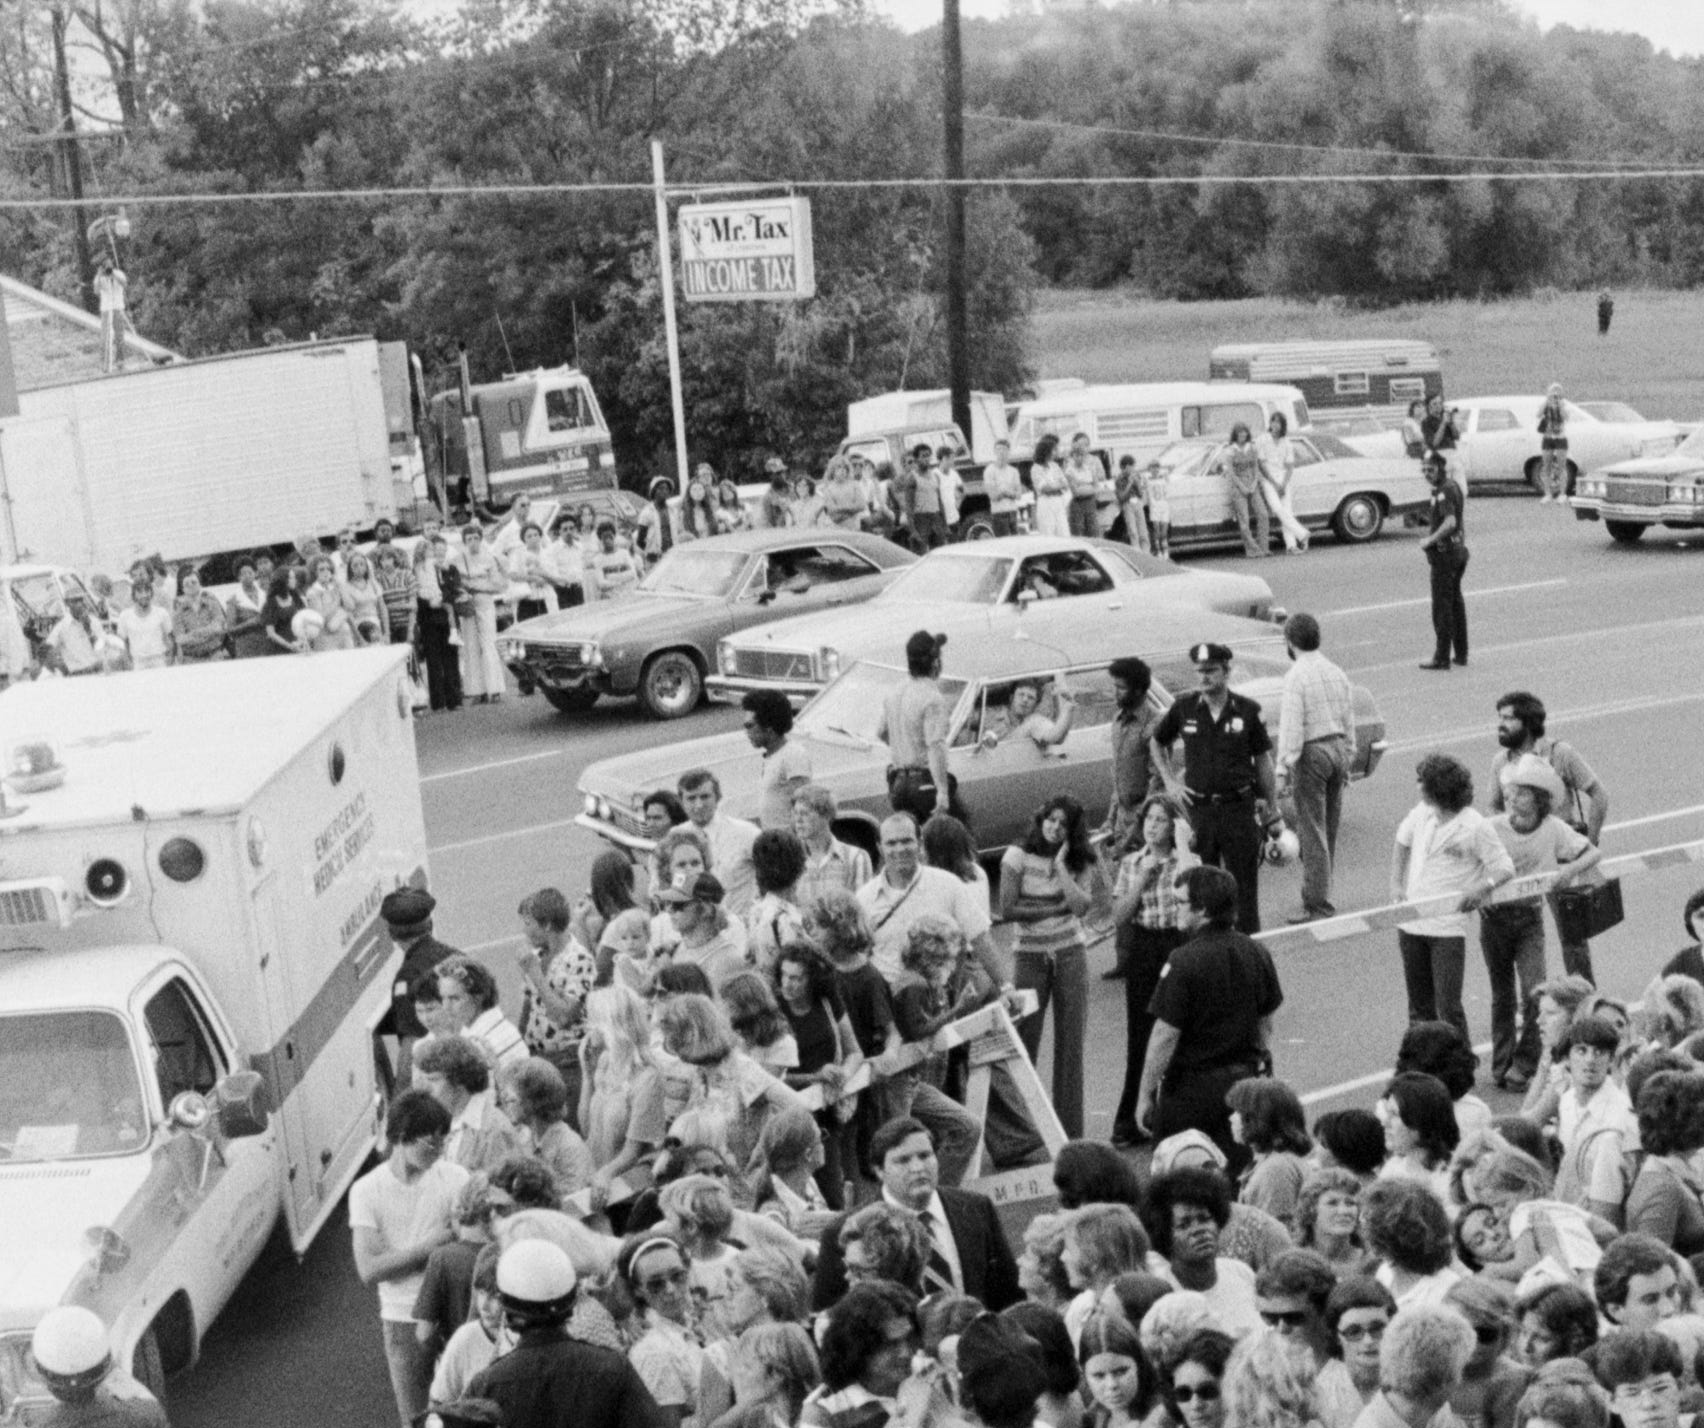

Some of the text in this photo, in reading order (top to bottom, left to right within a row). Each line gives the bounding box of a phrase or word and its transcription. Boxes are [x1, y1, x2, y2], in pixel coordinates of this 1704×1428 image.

[704, 212, 789, 242] Mr. Tax
[686, 257, 796, 294] INCOME TAX
